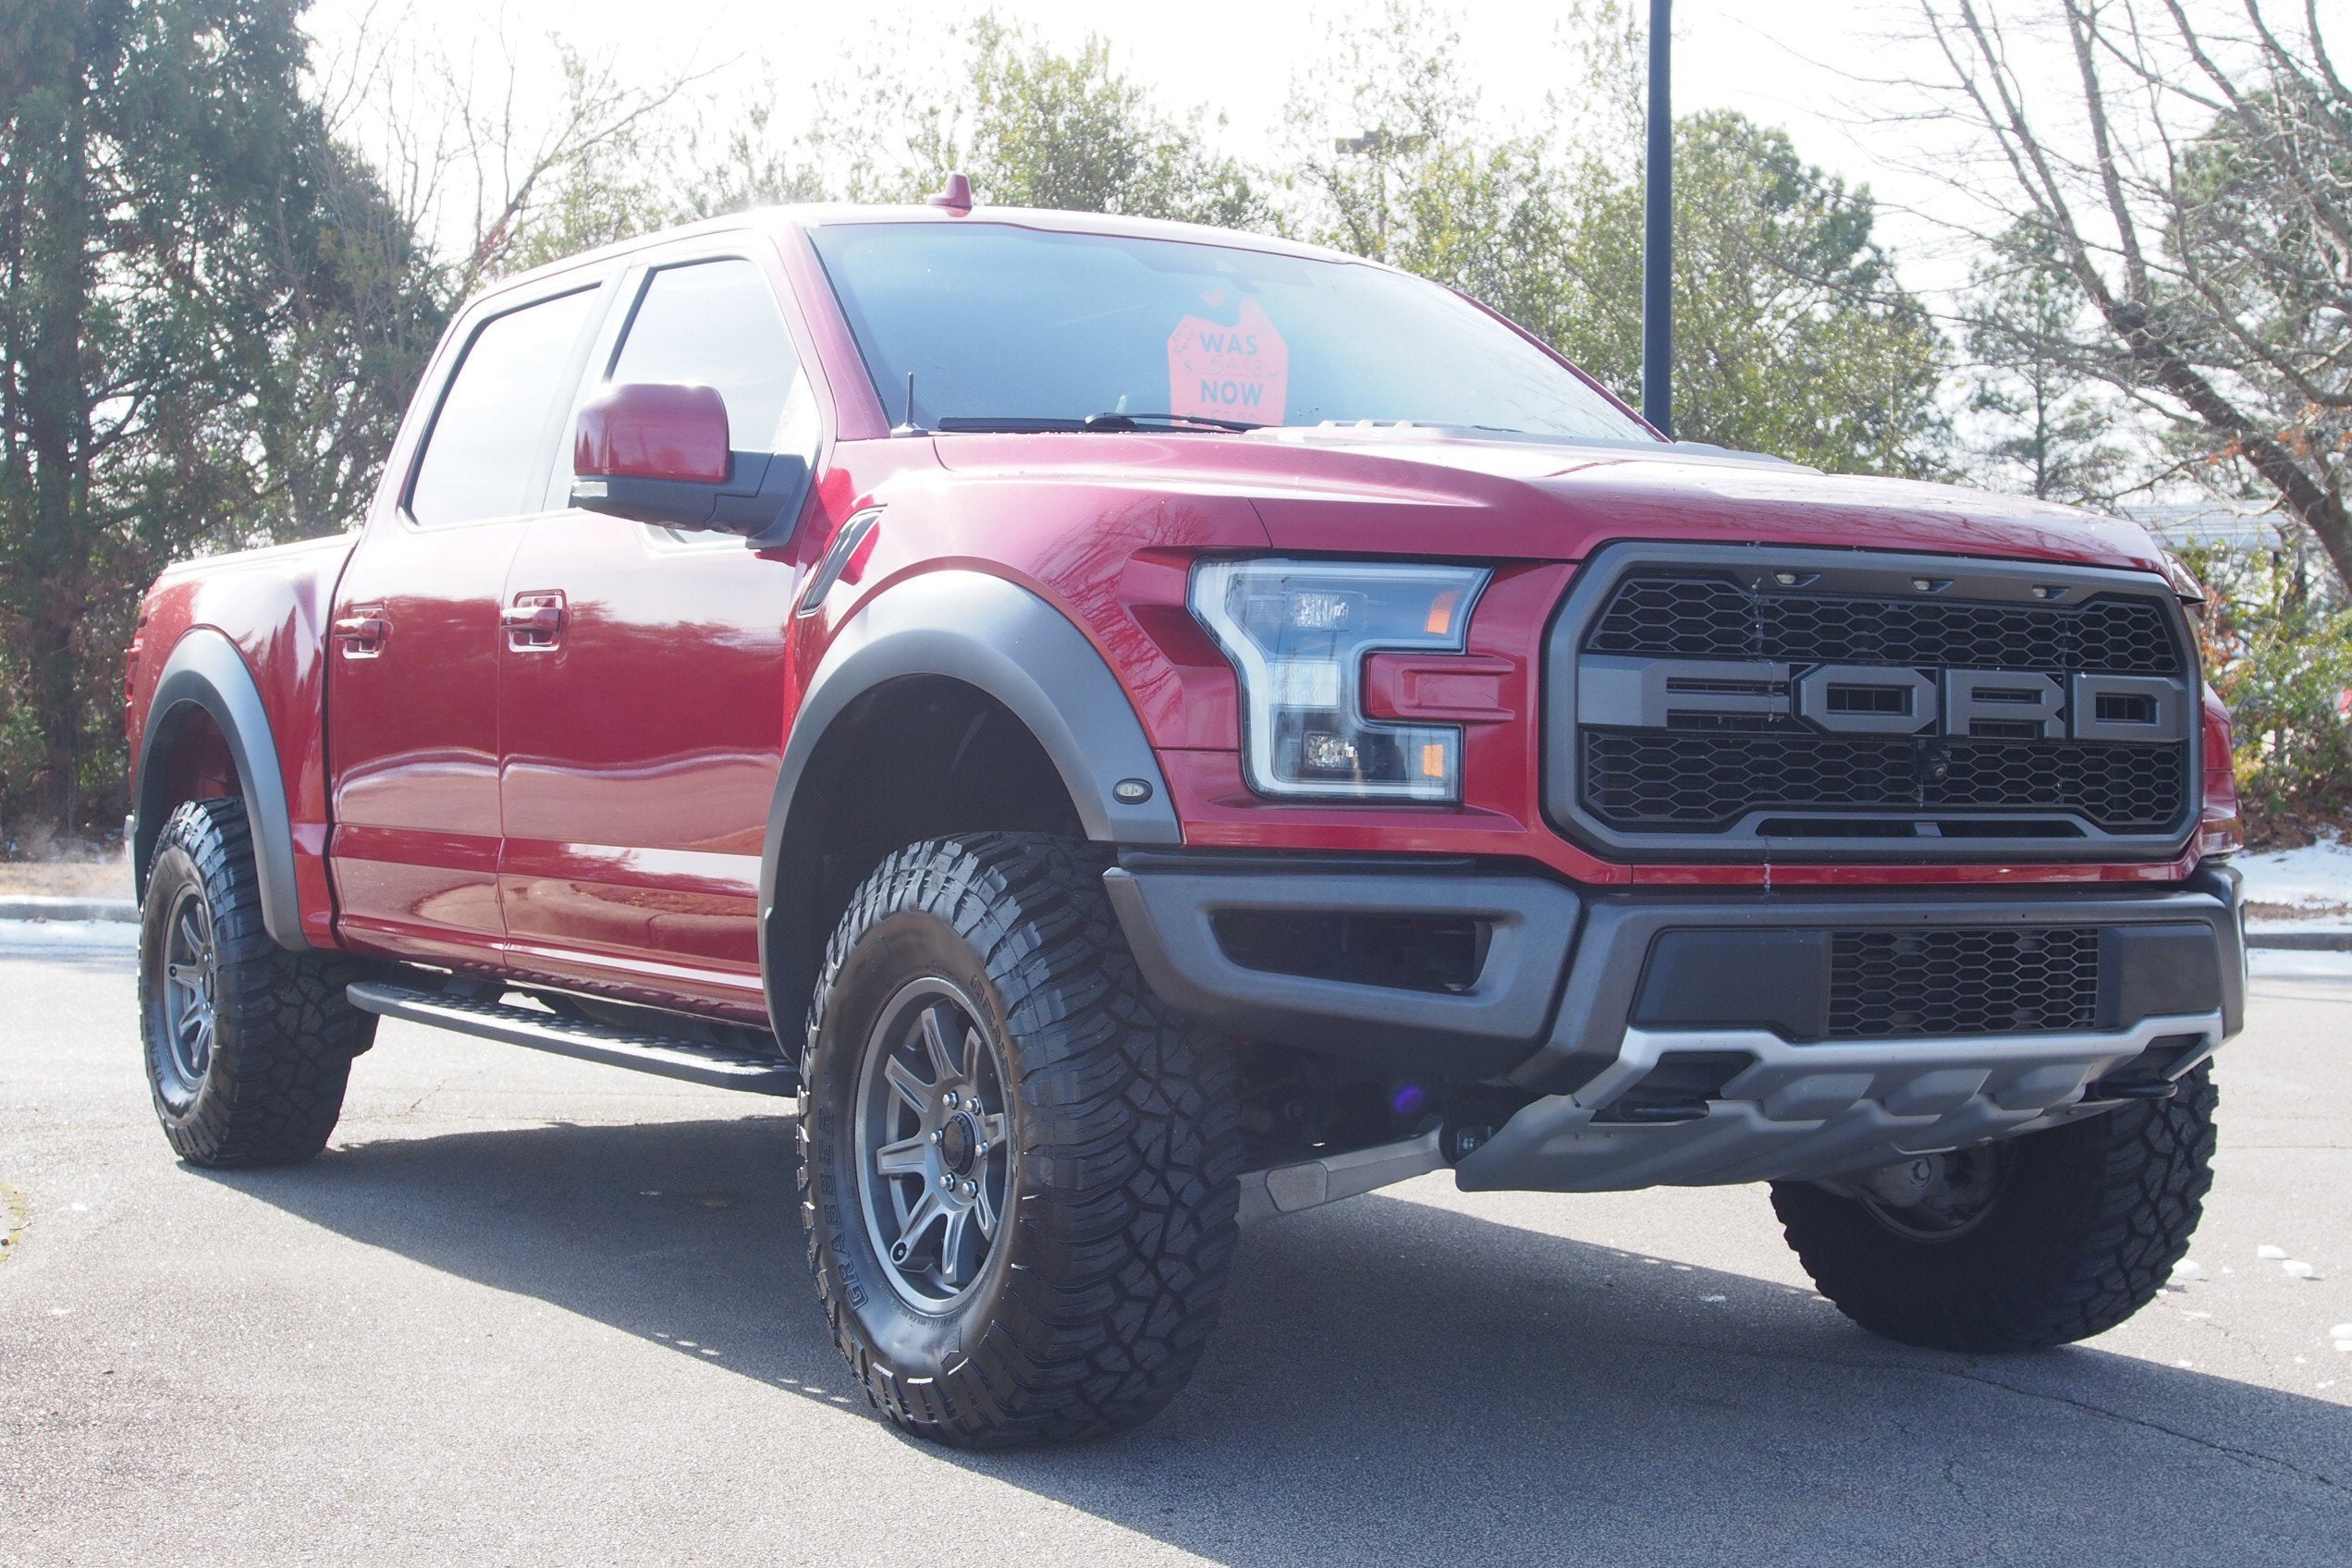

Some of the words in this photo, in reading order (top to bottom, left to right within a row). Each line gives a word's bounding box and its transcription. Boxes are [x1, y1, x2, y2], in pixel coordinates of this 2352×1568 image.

[1200, 332, 1258, 355] WAS
[1201, 379, 1264, 406] NOW
[1577, 653, 2187, 741] FORD
